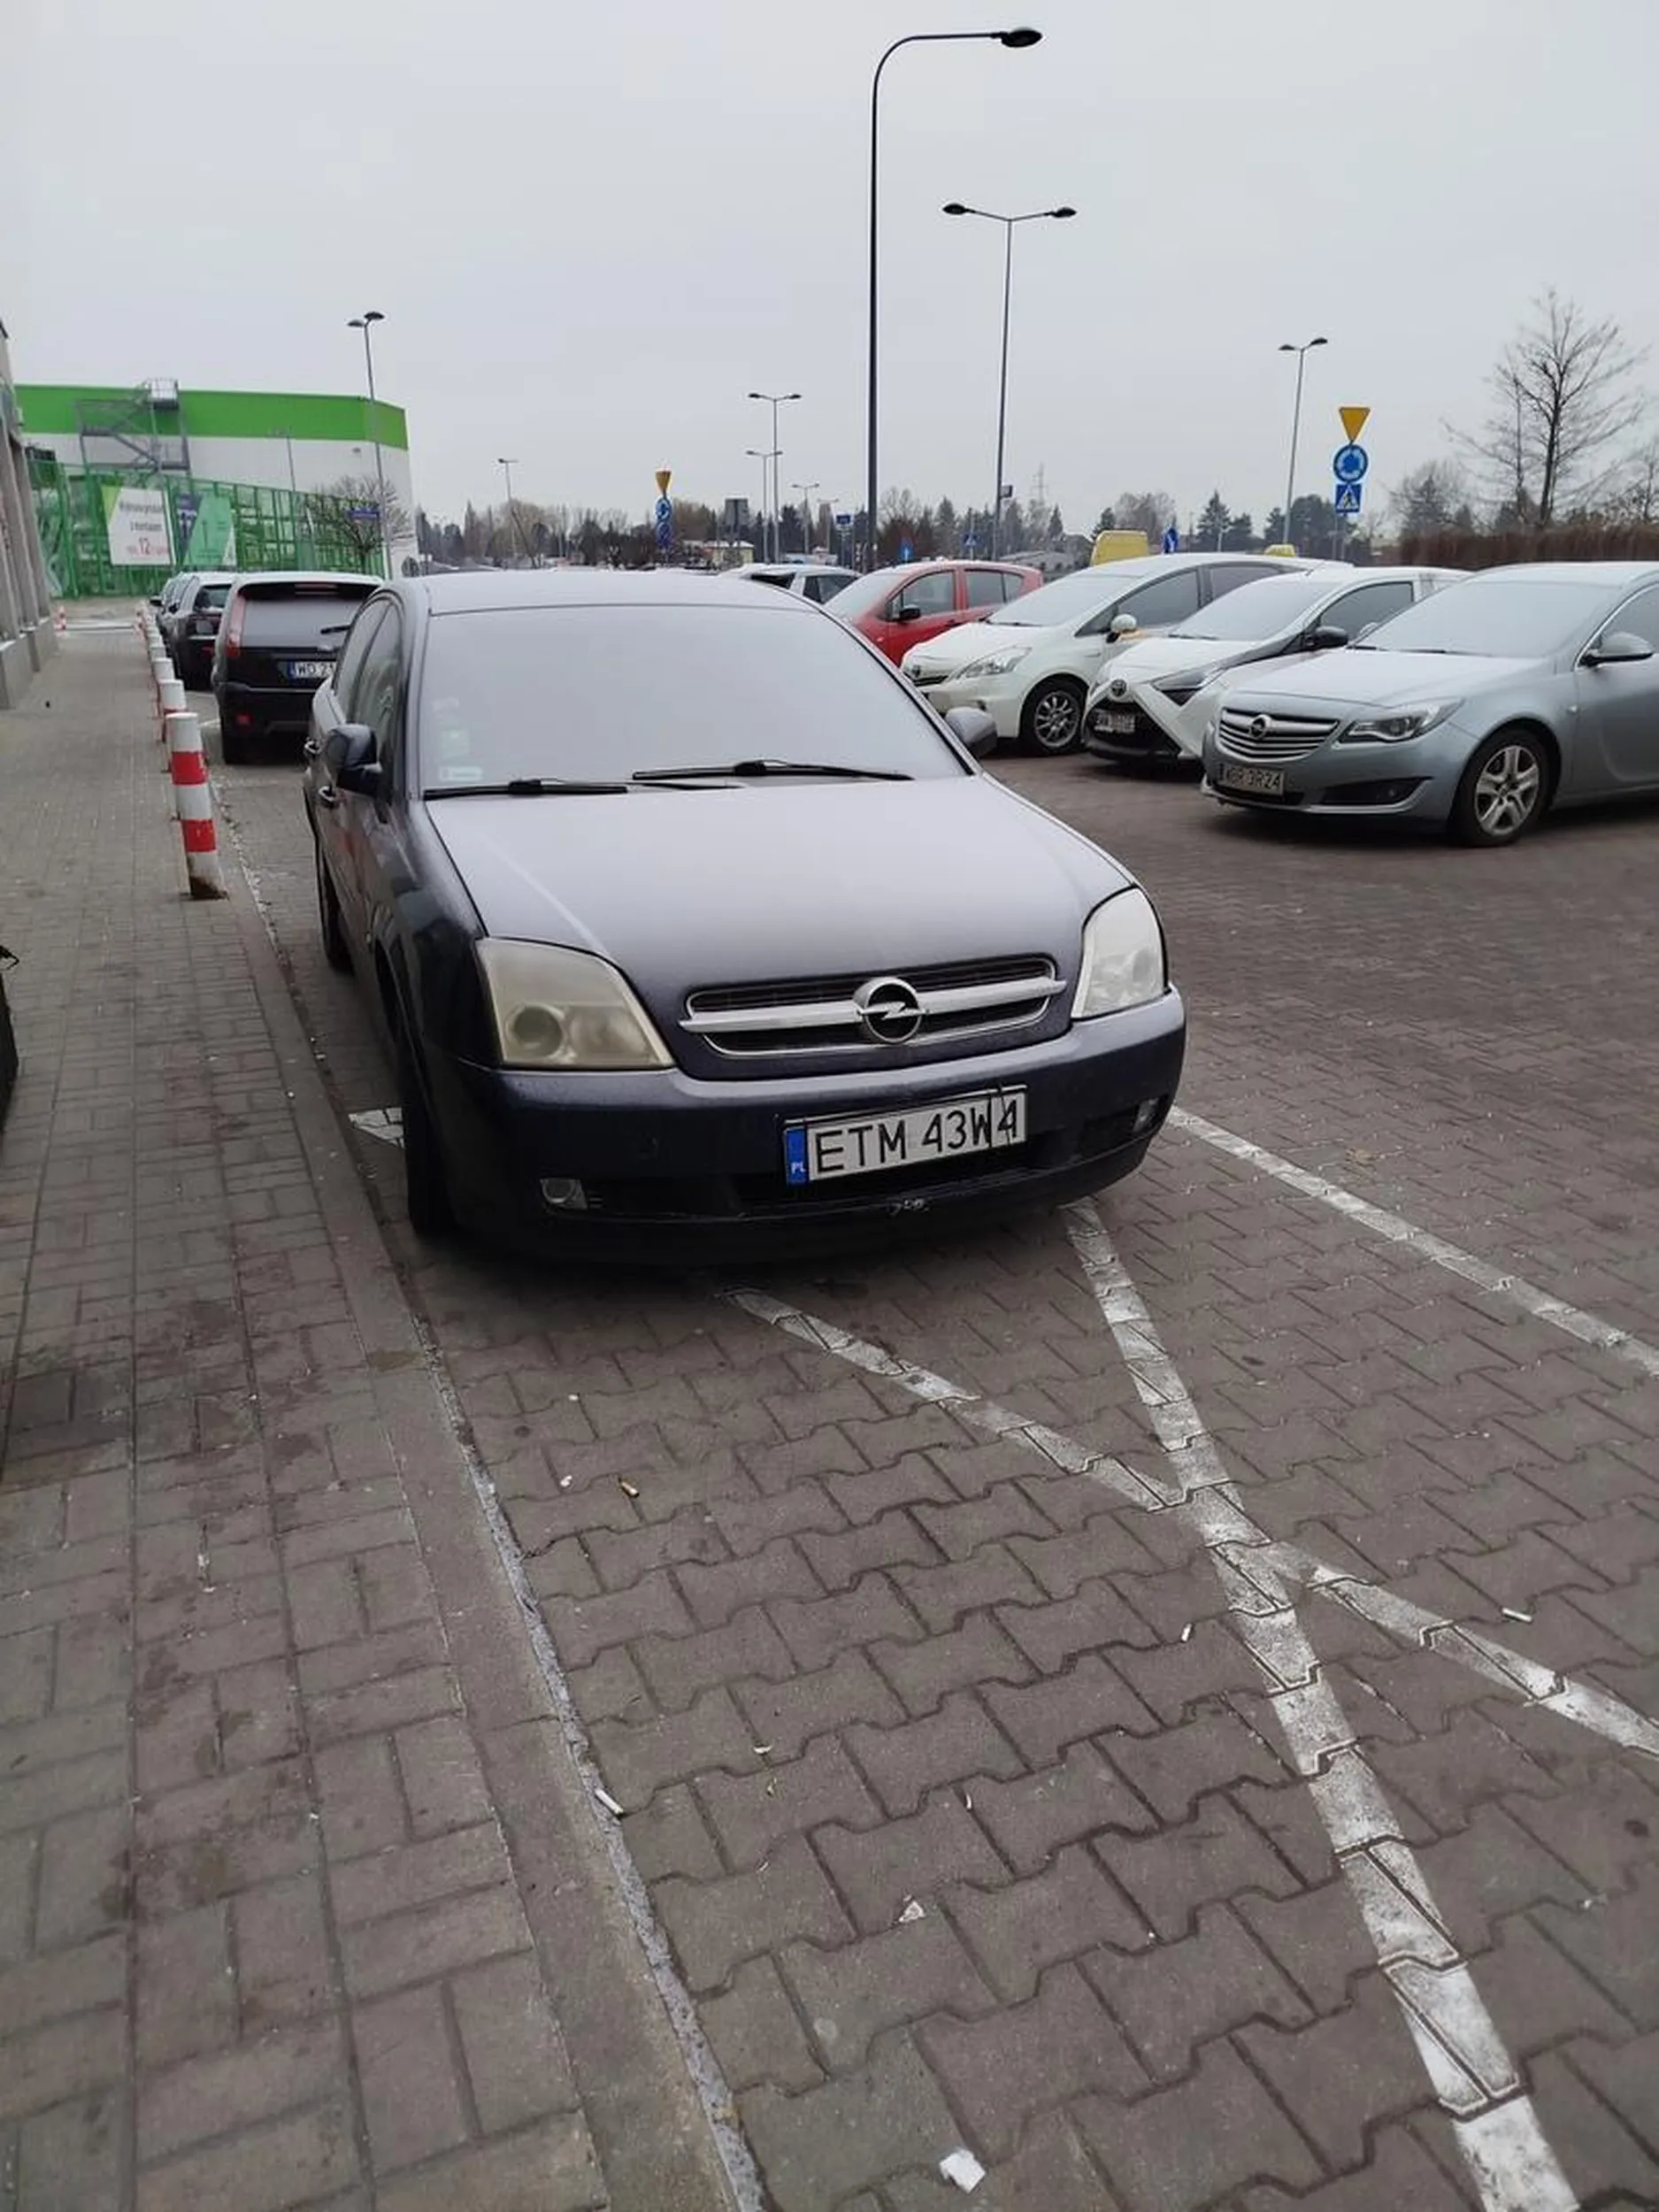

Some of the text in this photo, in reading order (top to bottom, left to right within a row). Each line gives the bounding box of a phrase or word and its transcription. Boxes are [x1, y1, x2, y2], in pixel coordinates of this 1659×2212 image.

[815, 1099, 1018, 1173] ETM 43W4
[791, 1161, 807, 1173] PL
